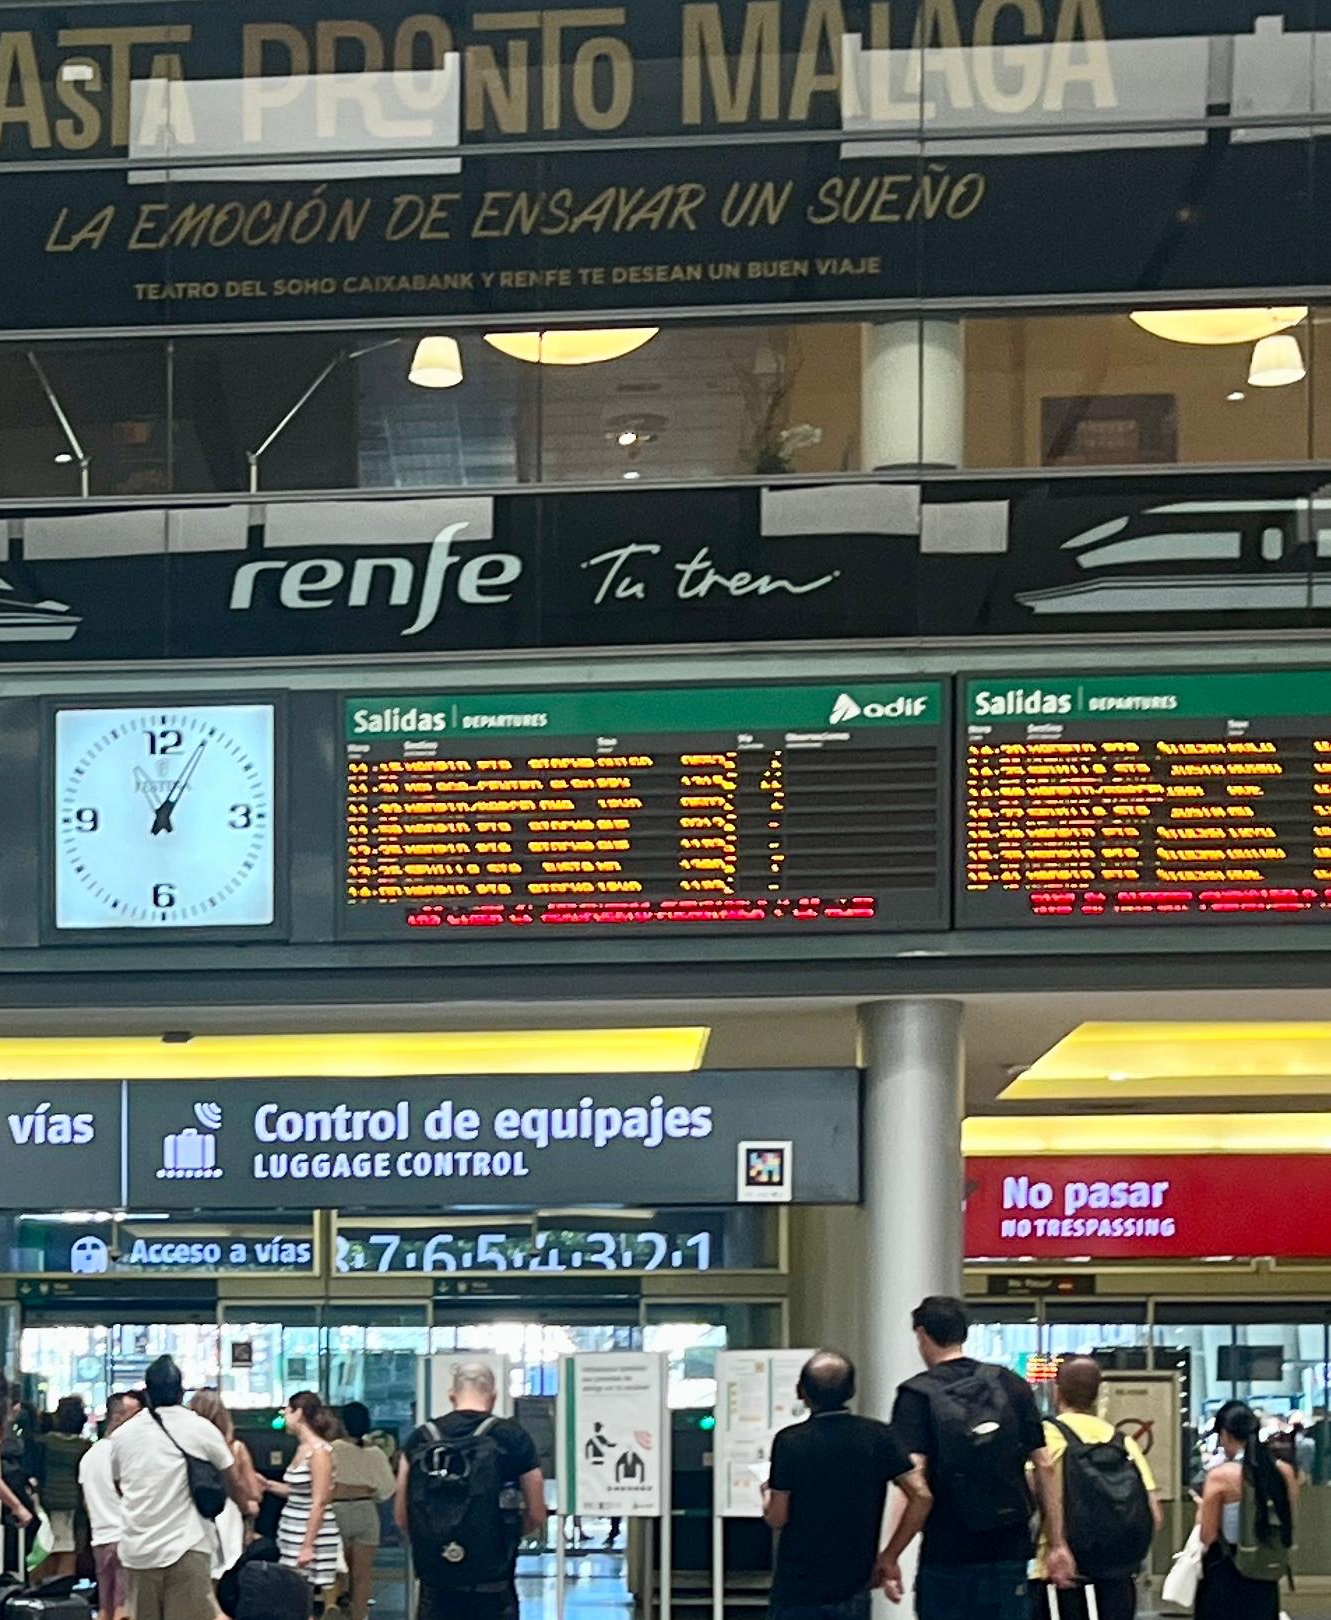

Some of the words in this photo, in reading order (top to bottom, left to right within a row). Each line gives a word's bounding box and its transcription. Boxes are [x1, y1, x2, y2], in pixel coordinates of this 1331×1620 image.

[241, 8, 634, 142] PRONTO
[45, 205, 114, 253] LA
[128, 183, 366, 250] EMOCIÓN
[386, 193, 461, 241] DE
[472, 183, 705, 238] ENSAYAR
[721, 180, 793, 228] UN
[807, 164, 985, 224] SUEÑO
[134, 282, 219, 300] TEATRO
[225, 281, 267, 298] DEL
[273, 278, 336, 295] SOHO
[343, 272, 474, 293] CAIXABANK
[481, 271, 495, 288] Y
[499, 269, 571, 289] RENFE
[577, 267, 605, 285] TE
[612, 264, 702, 284] DESEAN
[708, 262, 740, 280] UN
[747, 260, 809, 279] BUEN
[816, 256, 881, 276] VIAJE
[229, 520, 523, 636] renfe
[581, 543, 661, 604] Tu
[675, 547, 841, 599] tren
[862, 696, 929, 718] adif
[975, 689, 1072, 716] Salidas
[1088, 695, 1178, 711] DEPARTURES
[353, 707, 447, 733] Salidas
[462, 713, 548, 729] DEPARTURES
[144, 730, 185, 755] 12
[75, 808, 98, 833] 9
[228, 803, 252, 829] 3
[153, 883, 176, 908] 6
[8, 1102, 94, 1145] vías
[254, 1101, 409, 1142] Control
[424, 1100, 480, 1141] de
[494, 1096, 713, 1148] equipajes
[254, 1152, 390, 1179] LUGGAGE
[396, 1150, 529, 1177] CONTROL
[1003, 1176, 1053, 1210] No
[1065, 1180, 1170, 1214] pasar
[1001, 1219, 1032, 1237] NO
[1034, 1217, 1176, 1237] TRESPASSING
[132, 1238, 221, 1265] Acceso
[230, 1244, 247, 1264] a
[255, 1234, 311, 1265] vías
